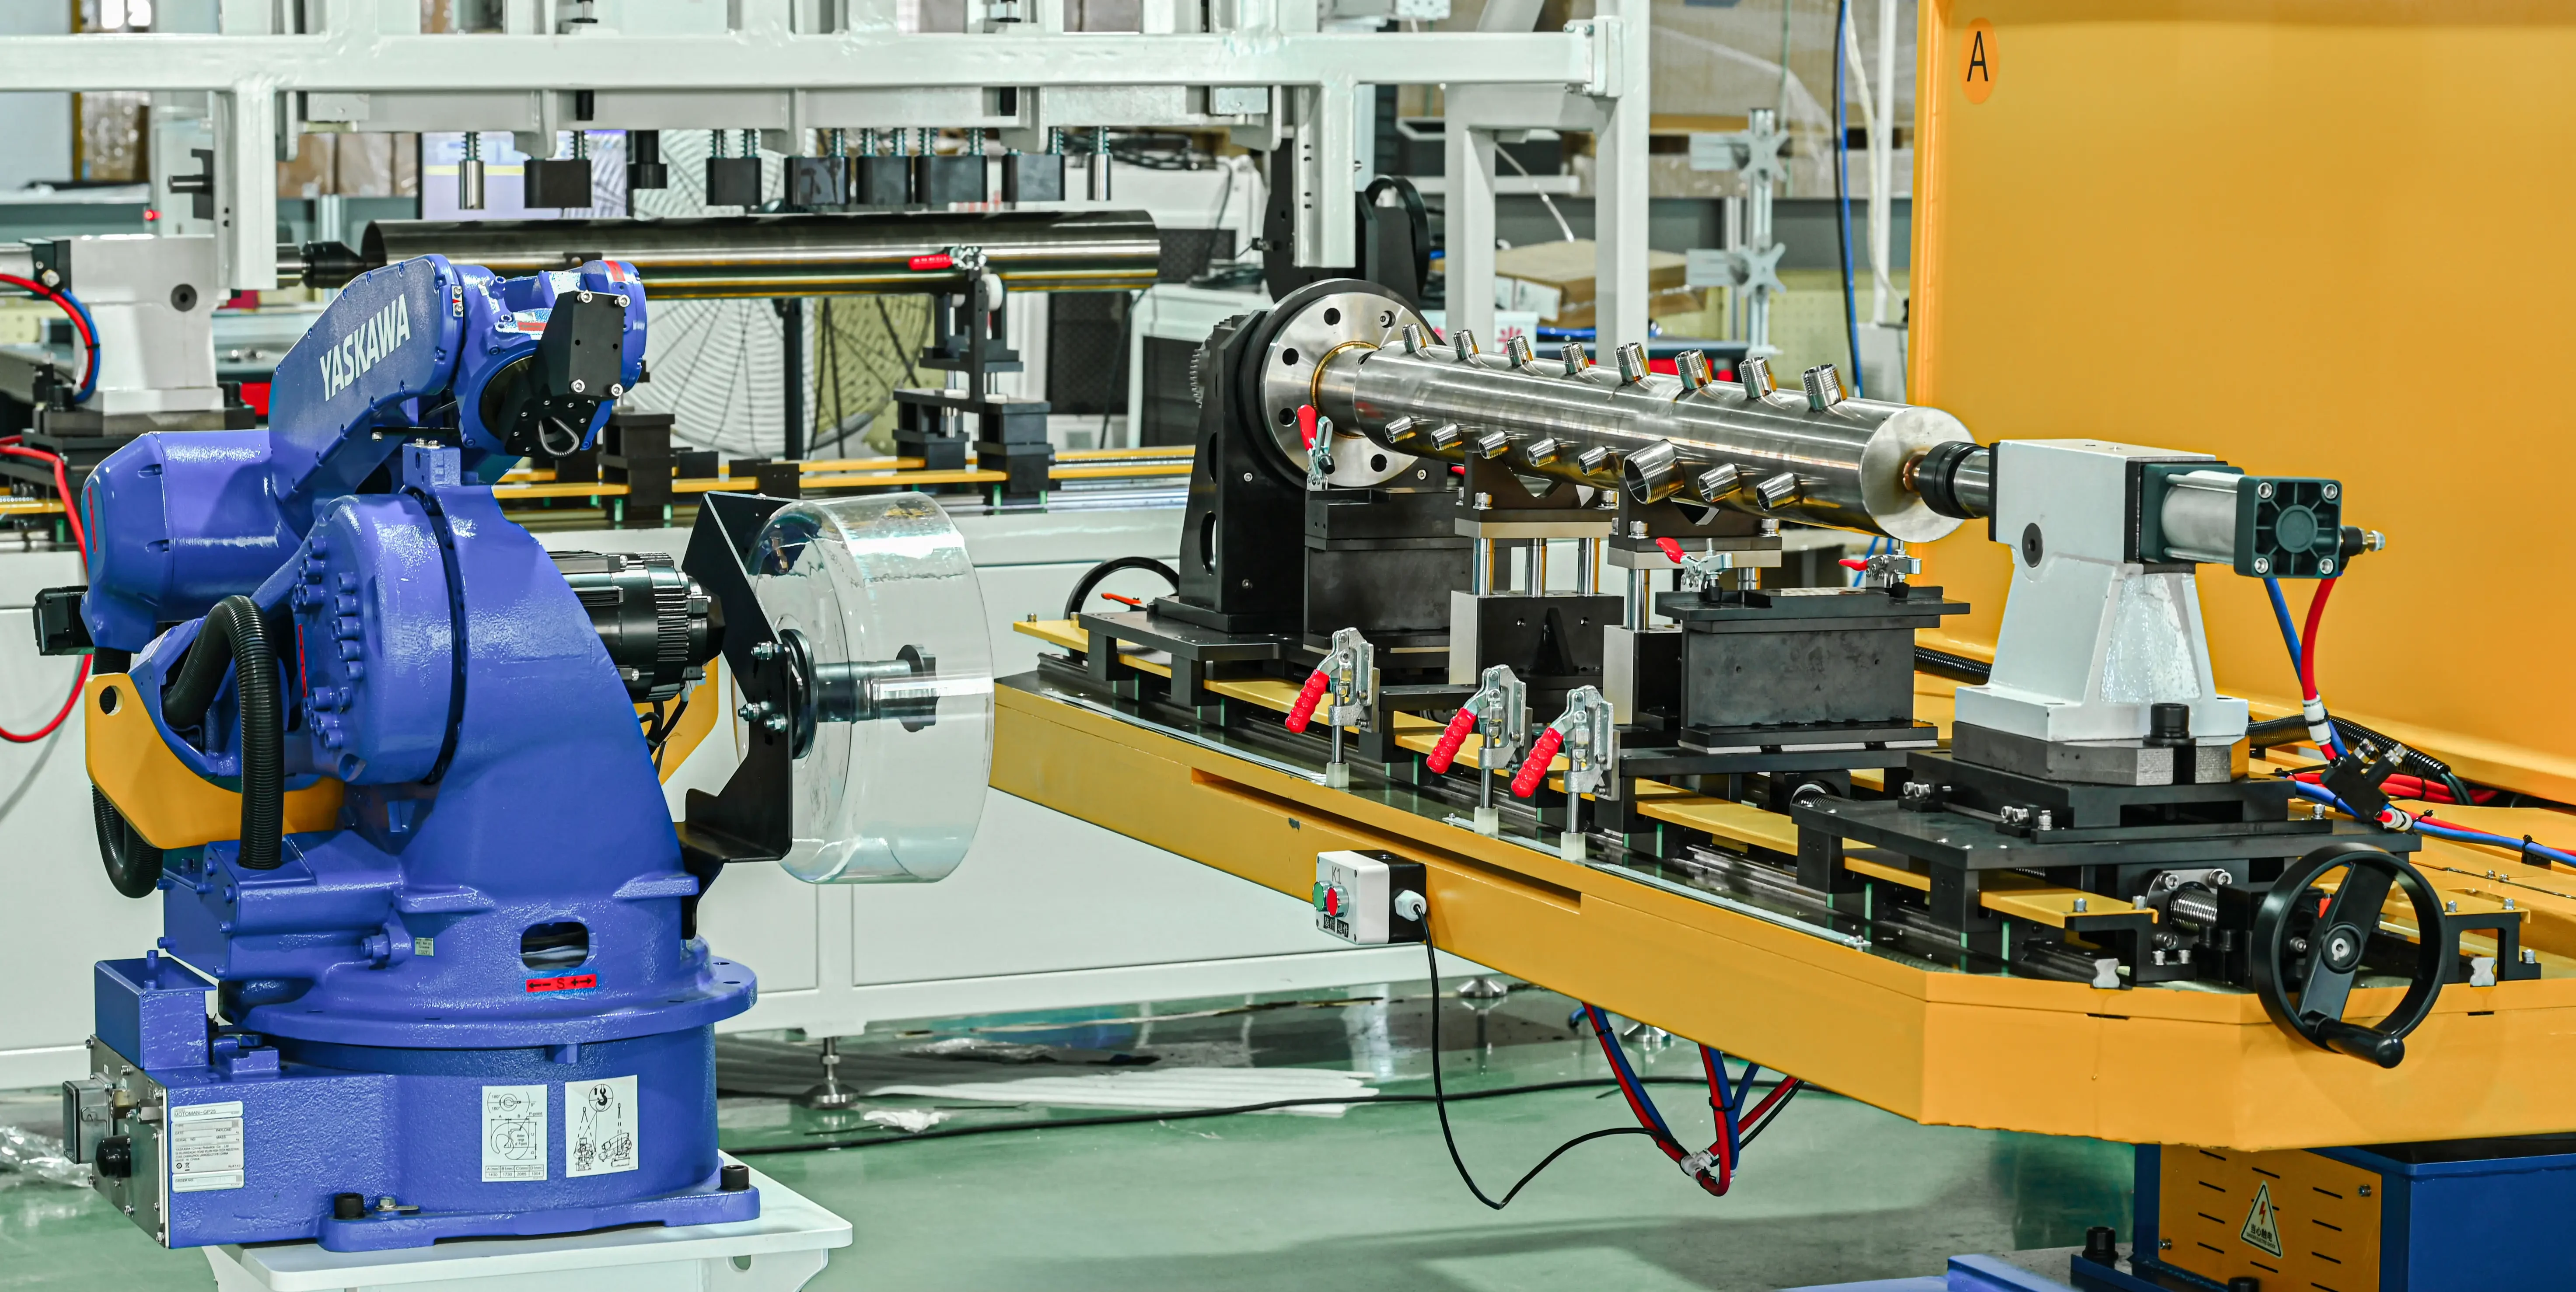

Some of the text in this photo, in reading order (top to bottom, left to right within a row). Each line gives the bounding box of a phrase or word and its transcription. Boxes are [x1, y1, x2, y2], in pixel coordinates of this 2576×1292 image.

[1967, 31, 1989, 82] A
[320, 293, 410, 402] YASKAWA
[1332, 866, 1341, 884] K1
[556, 978, 565, 989] S
[2251, 1223, 2272, 1242] 当心触电
